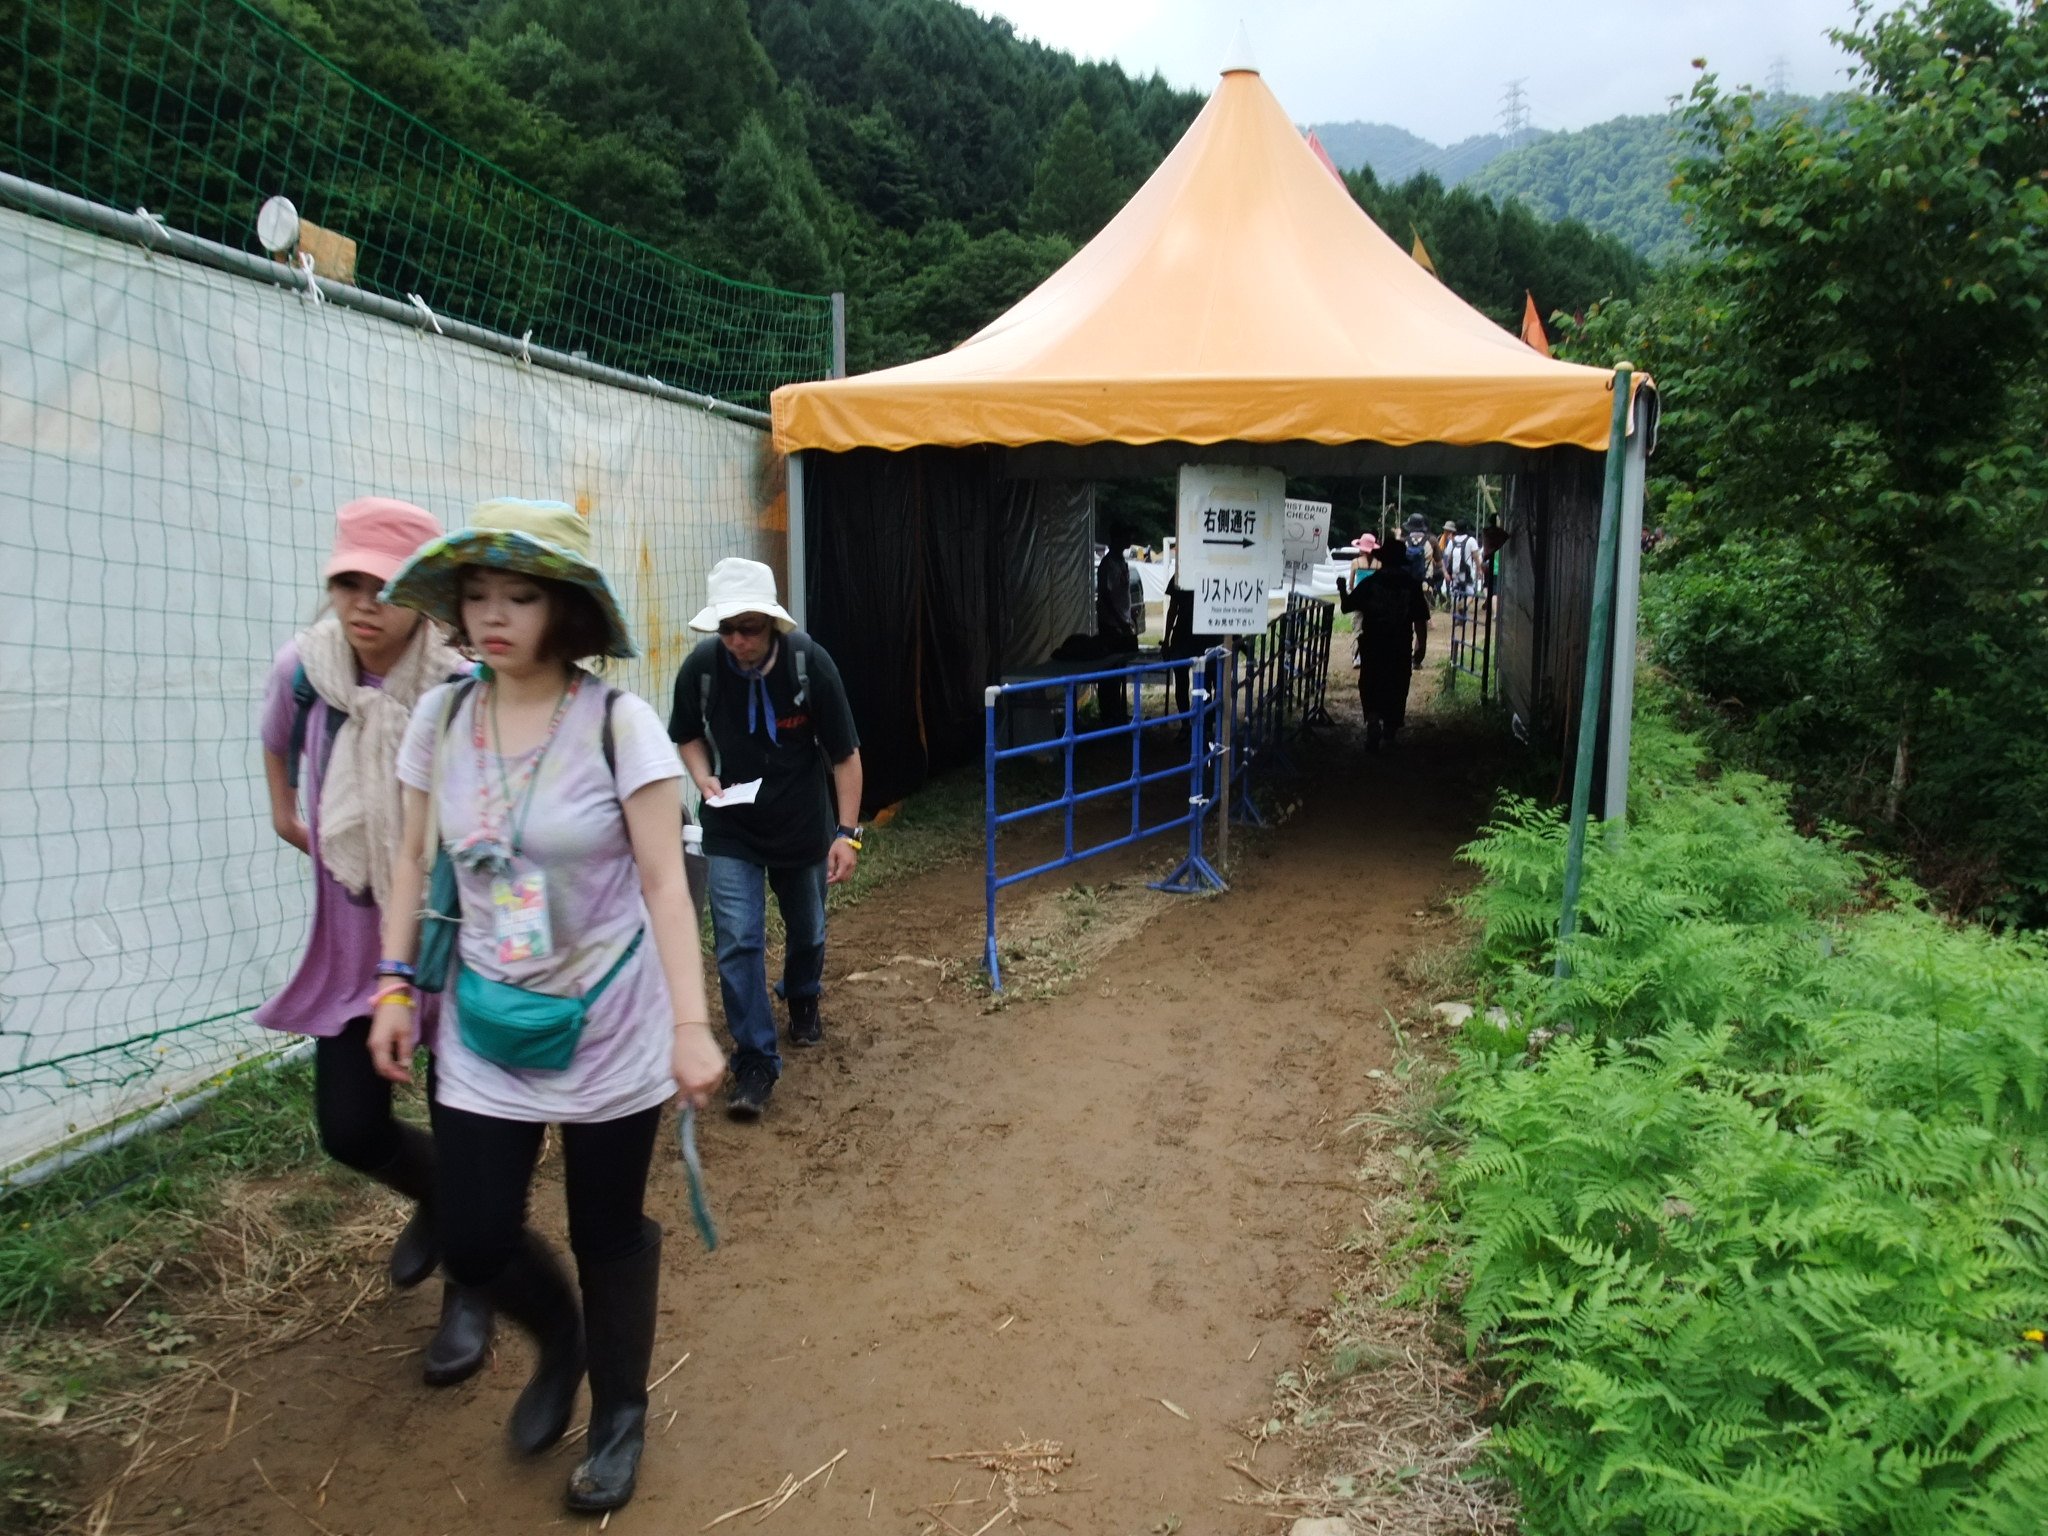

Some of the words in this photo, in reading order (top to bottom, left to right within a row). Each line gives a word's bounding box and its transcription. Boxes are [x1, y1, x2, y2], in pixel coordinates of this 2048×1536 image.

[1284, 502, 1301, 510] RIST
[1303, 504, 1328, 514] BAND
[1286, 511, 1315, 521] CHECK
[1204, 507, 1256, 535] 右側通行
[1202, 577, 1263, 604] リストバンド
